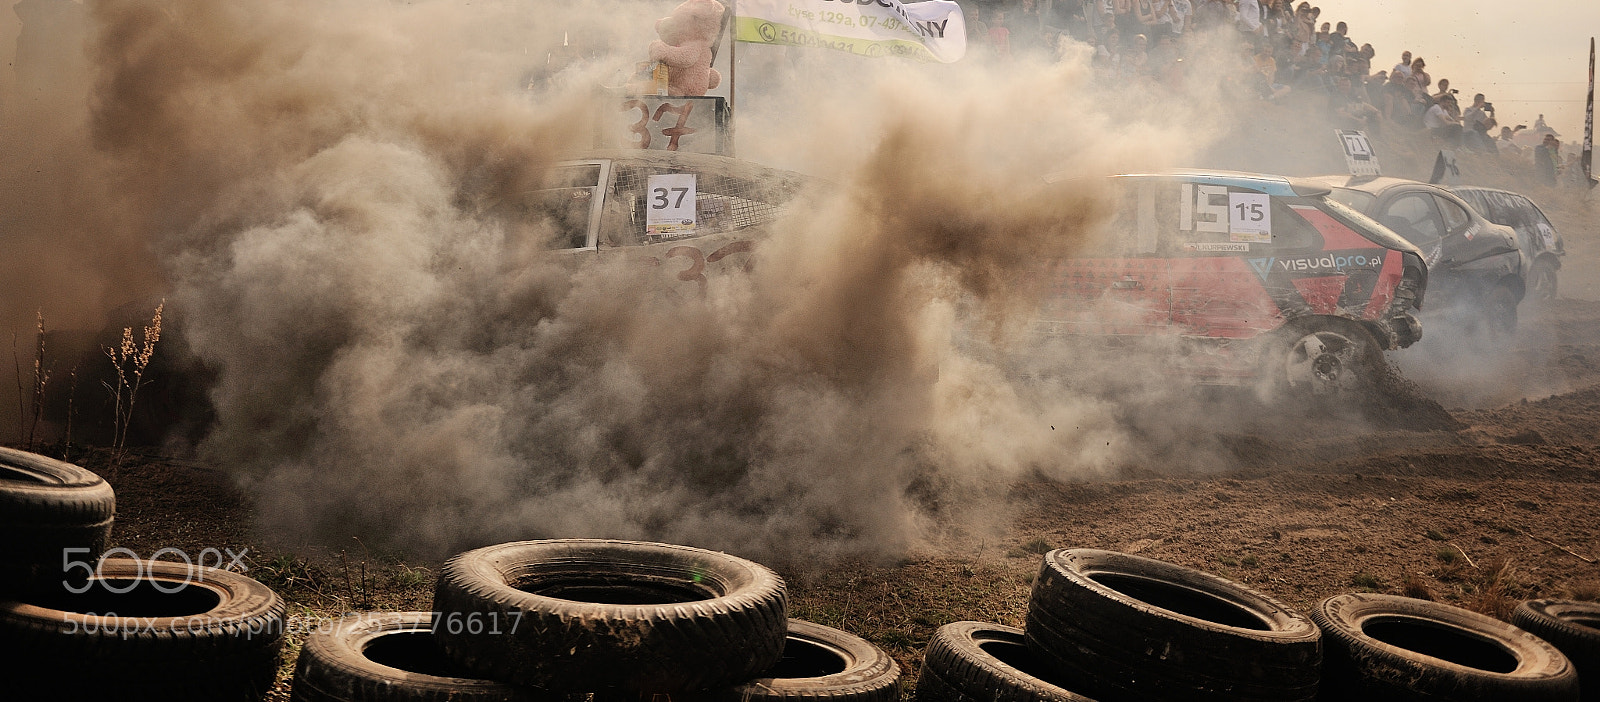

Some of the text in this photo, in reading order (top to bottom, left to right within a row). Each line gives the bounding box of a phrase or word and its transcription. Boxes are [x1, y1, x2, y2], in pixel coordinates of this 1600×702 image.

[818, 10, 855, 30] 129a,
[618, 99, 697, 151] 37
[652, 187, 689, 209] 37
[1180, 183, 1229, 232] 15
[1235, 202, 1265, 221] 15
[1280, 253, 1382, 270] visualpro.pl
